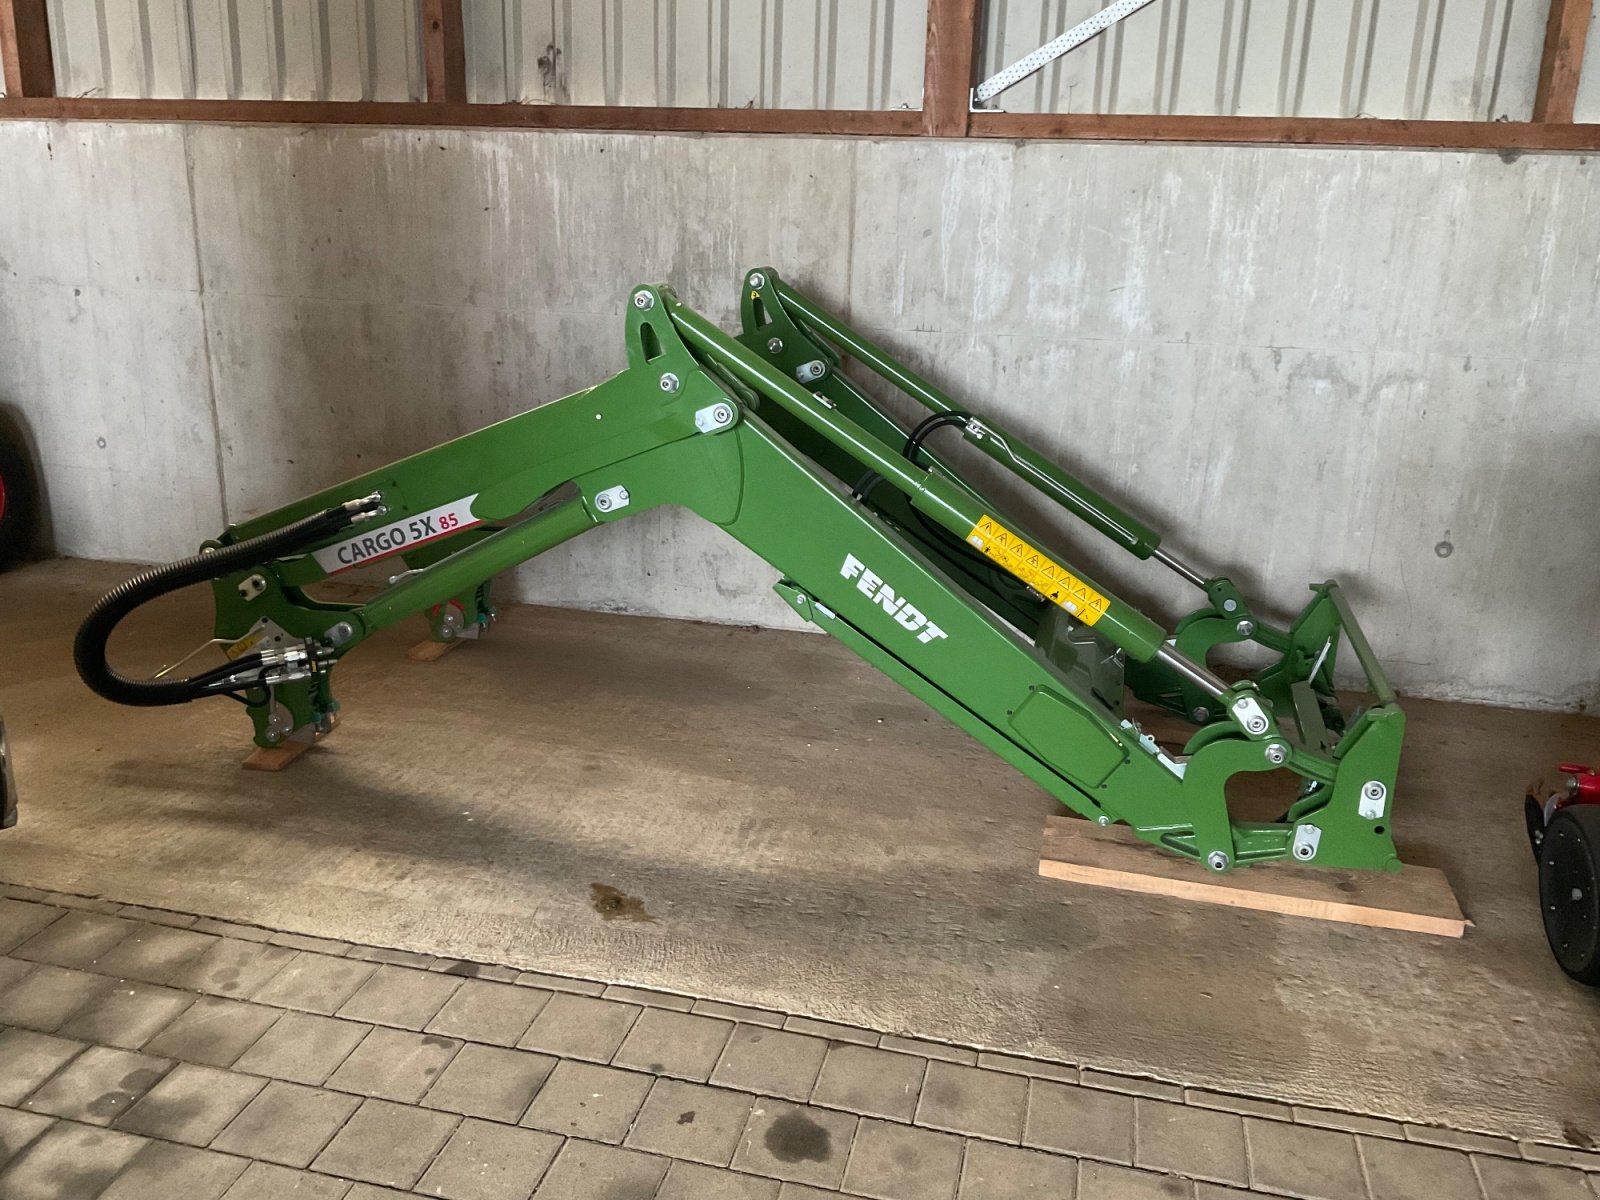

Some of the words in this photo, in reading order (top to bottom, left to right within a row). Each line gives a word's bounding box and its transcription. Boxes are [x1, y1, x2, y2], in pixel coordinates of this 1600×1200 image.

[337, 527, 406, 564] CARGO
[408, 516, 437, 540] 5X
[438, 513, 459, 530] 85
[840, 553, 949, 644] FENDT
